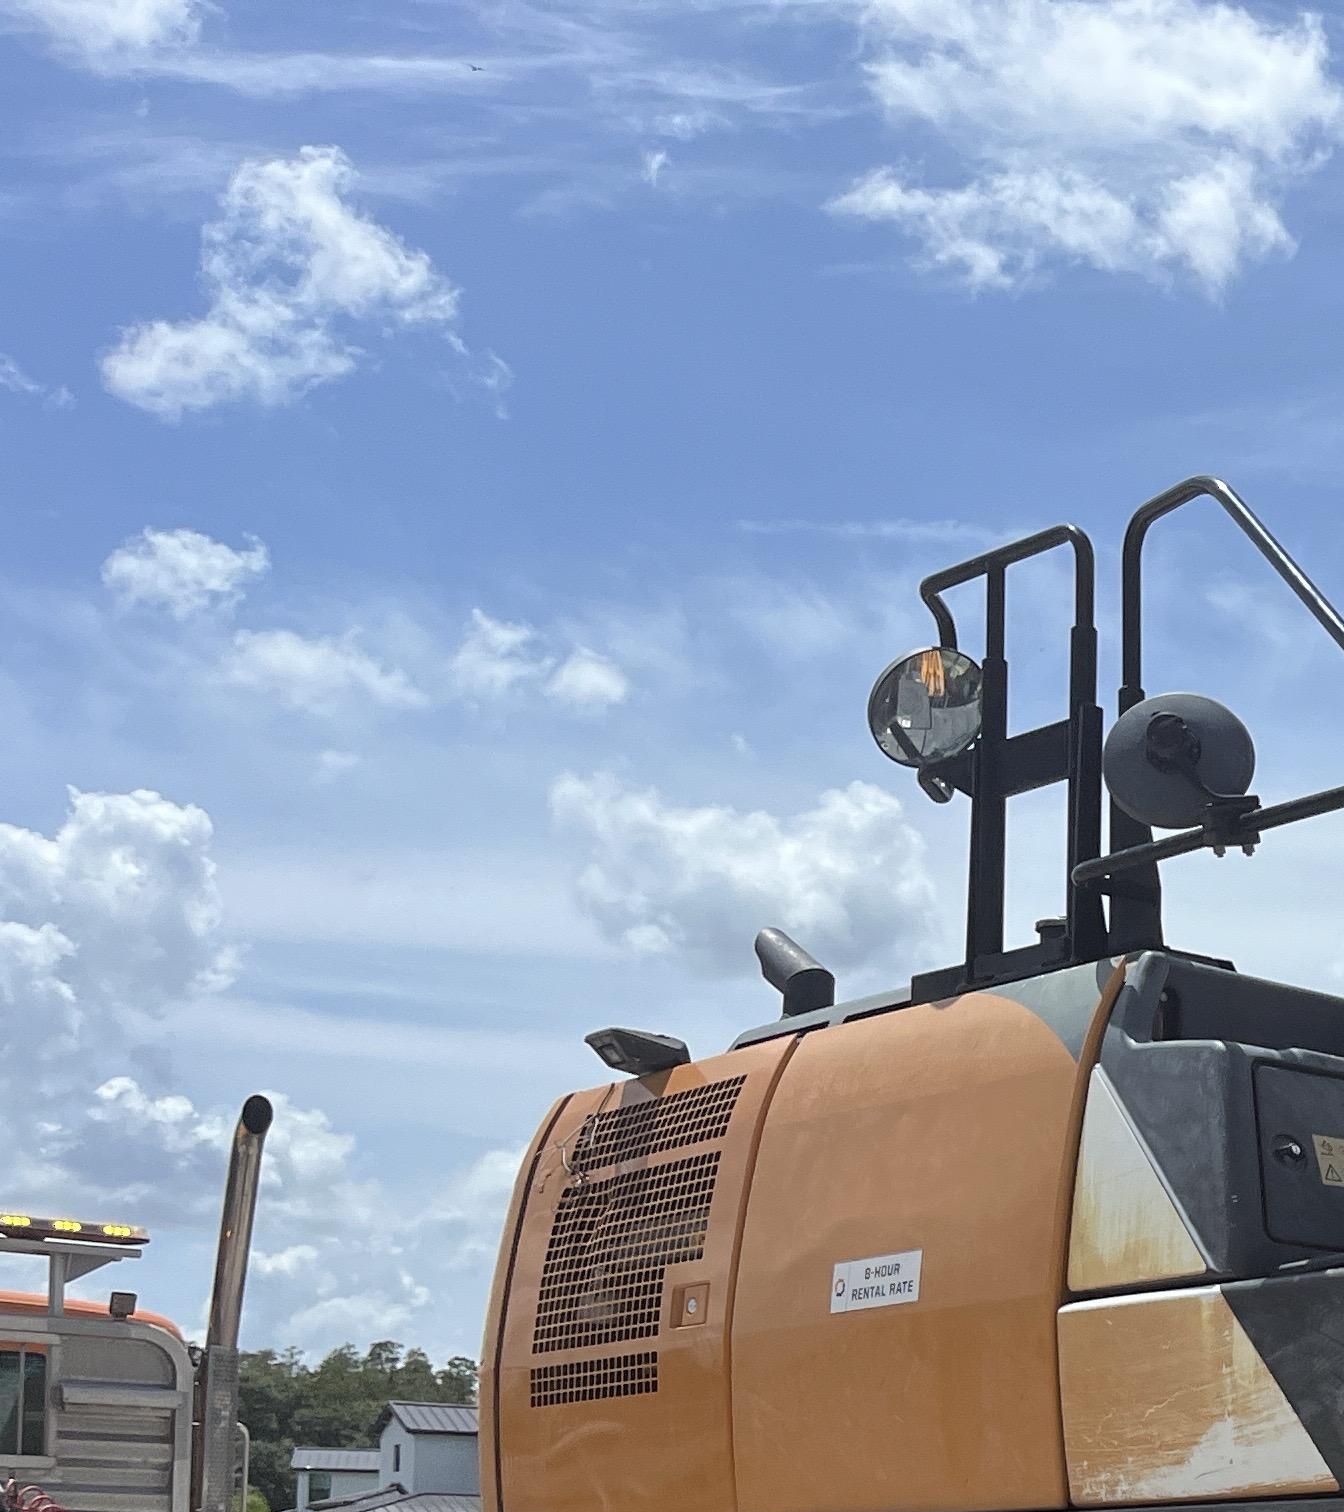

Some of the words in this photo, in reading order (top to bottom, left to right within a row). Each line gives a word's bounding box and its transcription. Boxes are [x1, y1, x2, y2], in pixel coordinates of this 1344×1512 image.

[864, 1263, 901, 1280] 8-HOUR
[851, 1285, 886, 1301] RENTAL
[889, 1279, 914, 1296] RATE
